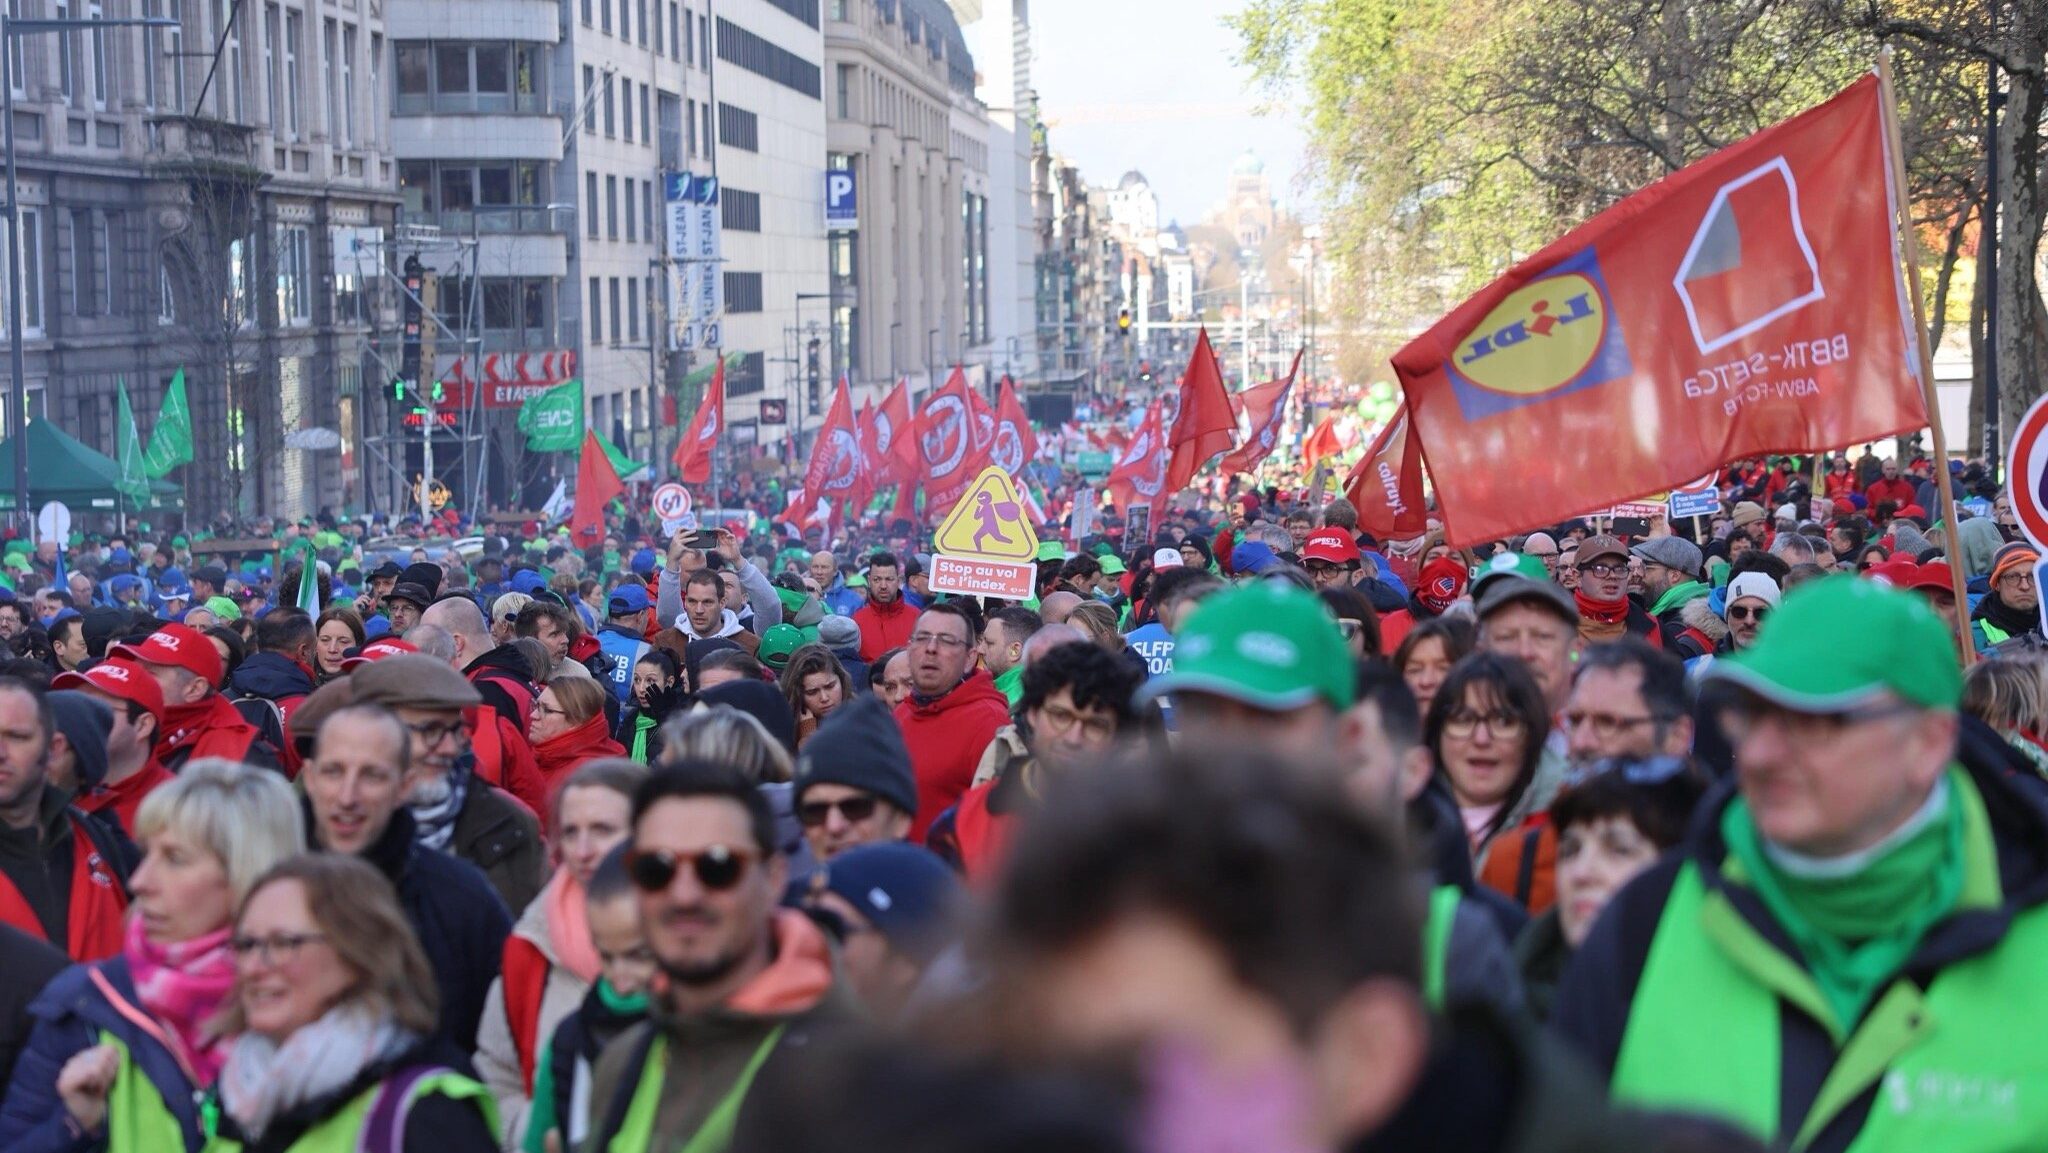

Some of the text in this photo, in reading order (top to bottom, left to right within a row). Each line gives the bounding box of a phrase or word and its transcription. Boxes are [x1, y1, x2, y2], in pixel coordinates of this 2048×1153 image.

[830, 175, 853, 207] P
[675, 205, 688, 255] ST-JEAN
[702, 209, 714, 255] ST-JAN
[1378, 462, 1407, 517] colruyt
[937, 574, 956, 586] de
[958, 575, 1006, 591] l'index
[939, 561, 1018, 579] Stop au vol
[1132, 641, 1175, 658] SLFP
